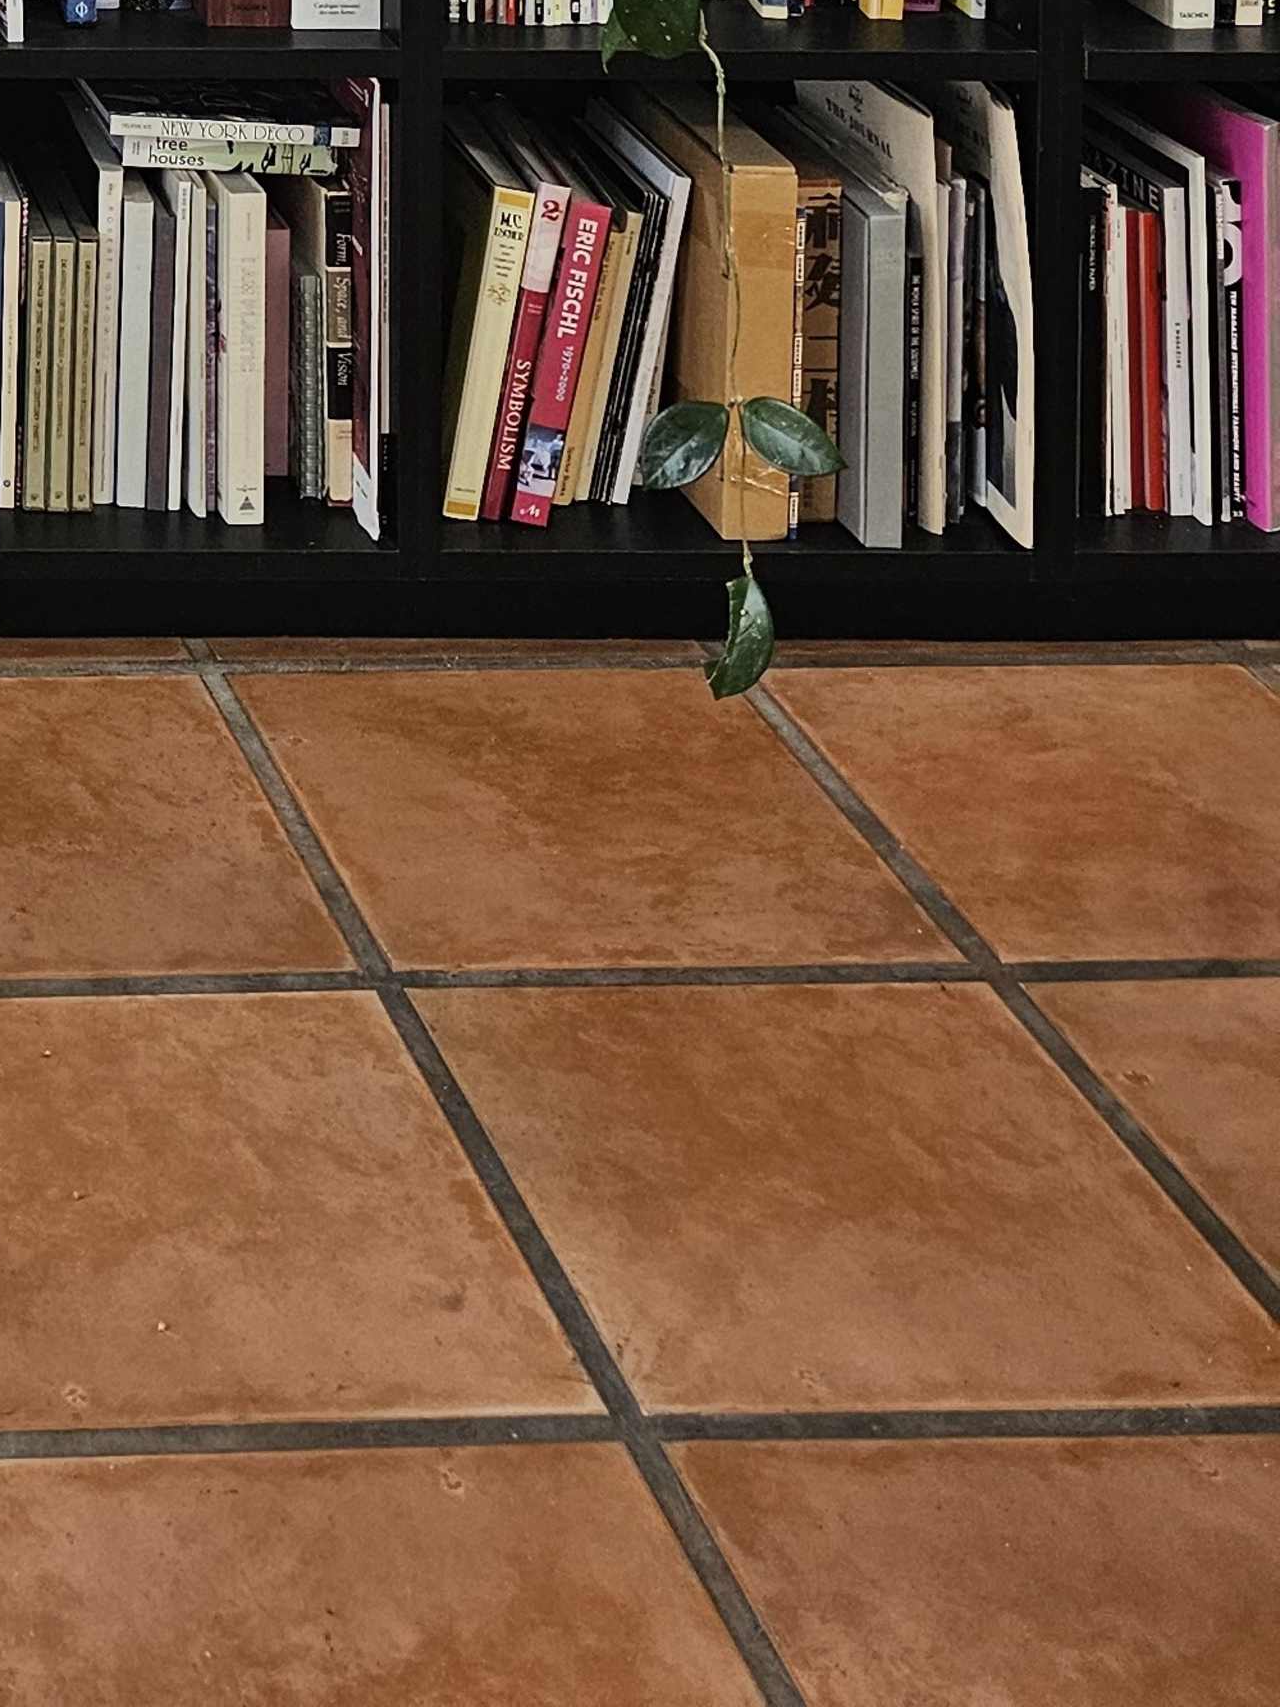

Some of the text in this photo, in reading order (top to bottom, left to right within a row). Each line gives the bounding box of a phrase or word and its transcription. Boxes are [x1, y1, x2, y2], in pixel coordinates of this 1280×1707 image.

[161, 120, 305, 142] NEW YORK DECO
[156, 137, 188, 151] tree
[148, 146, 204, 167] houses
[540, 199, 564, 223] 2
[493, 230, 526, 242] ESCHER
[556, 217, 599, 338] ERIC FISCHL
[1229, 307, 1238, 350] MAGAZINE
[496, 359, 532, 471] SYMBOLISM
